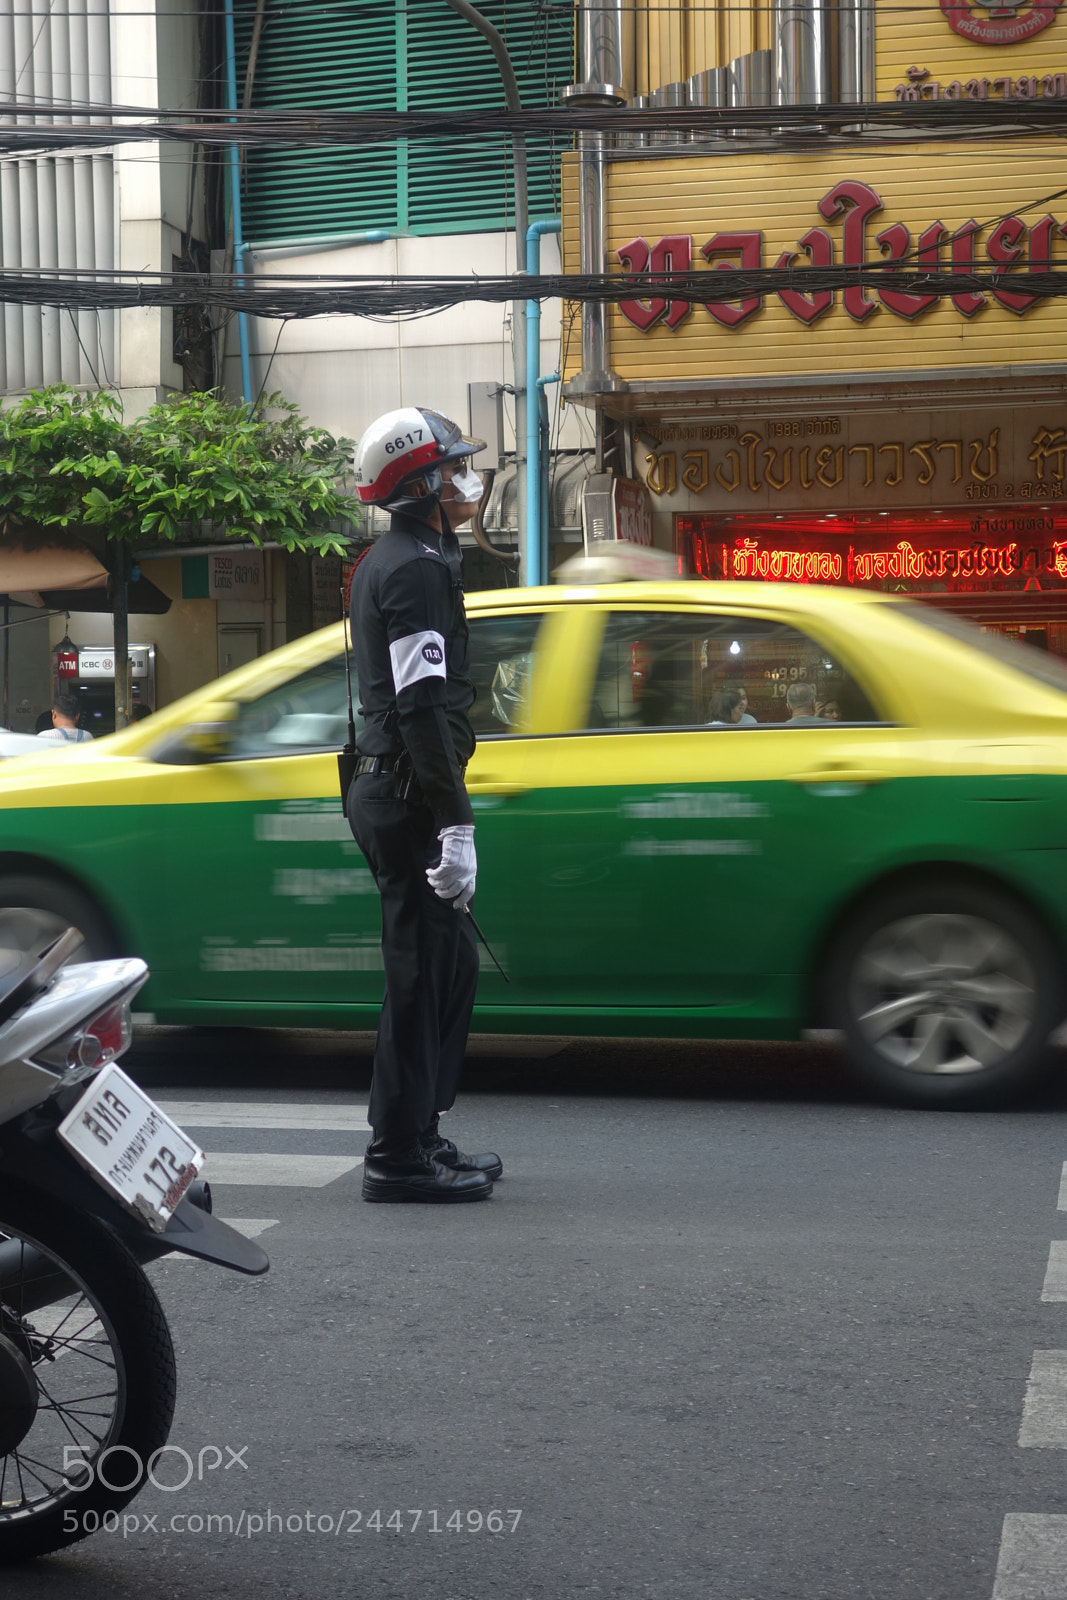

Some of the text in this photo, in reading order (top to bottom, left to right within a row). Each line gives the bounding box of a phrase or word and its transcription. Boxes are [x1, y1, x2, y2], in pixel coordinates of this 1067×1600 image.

[807, 416, 840, 435] จำกัด
[385, 429, 423, 455] 6617
[645, 427, 1000, 494] ทองใบเยาวราช
[965, 483, 1014, 499] สาขา 2
[970, 515, 1054, 533] ห้างขายทอง
[214, 557, 233, 570] TESCO
[733, 538, 842, 580] ห้างขายทอง
[59, 660, 76, 670] ATM
[108, 1111, 163, 1187] กรุงเทพมหานคร
[143, 1146, 186, 1198] 172
